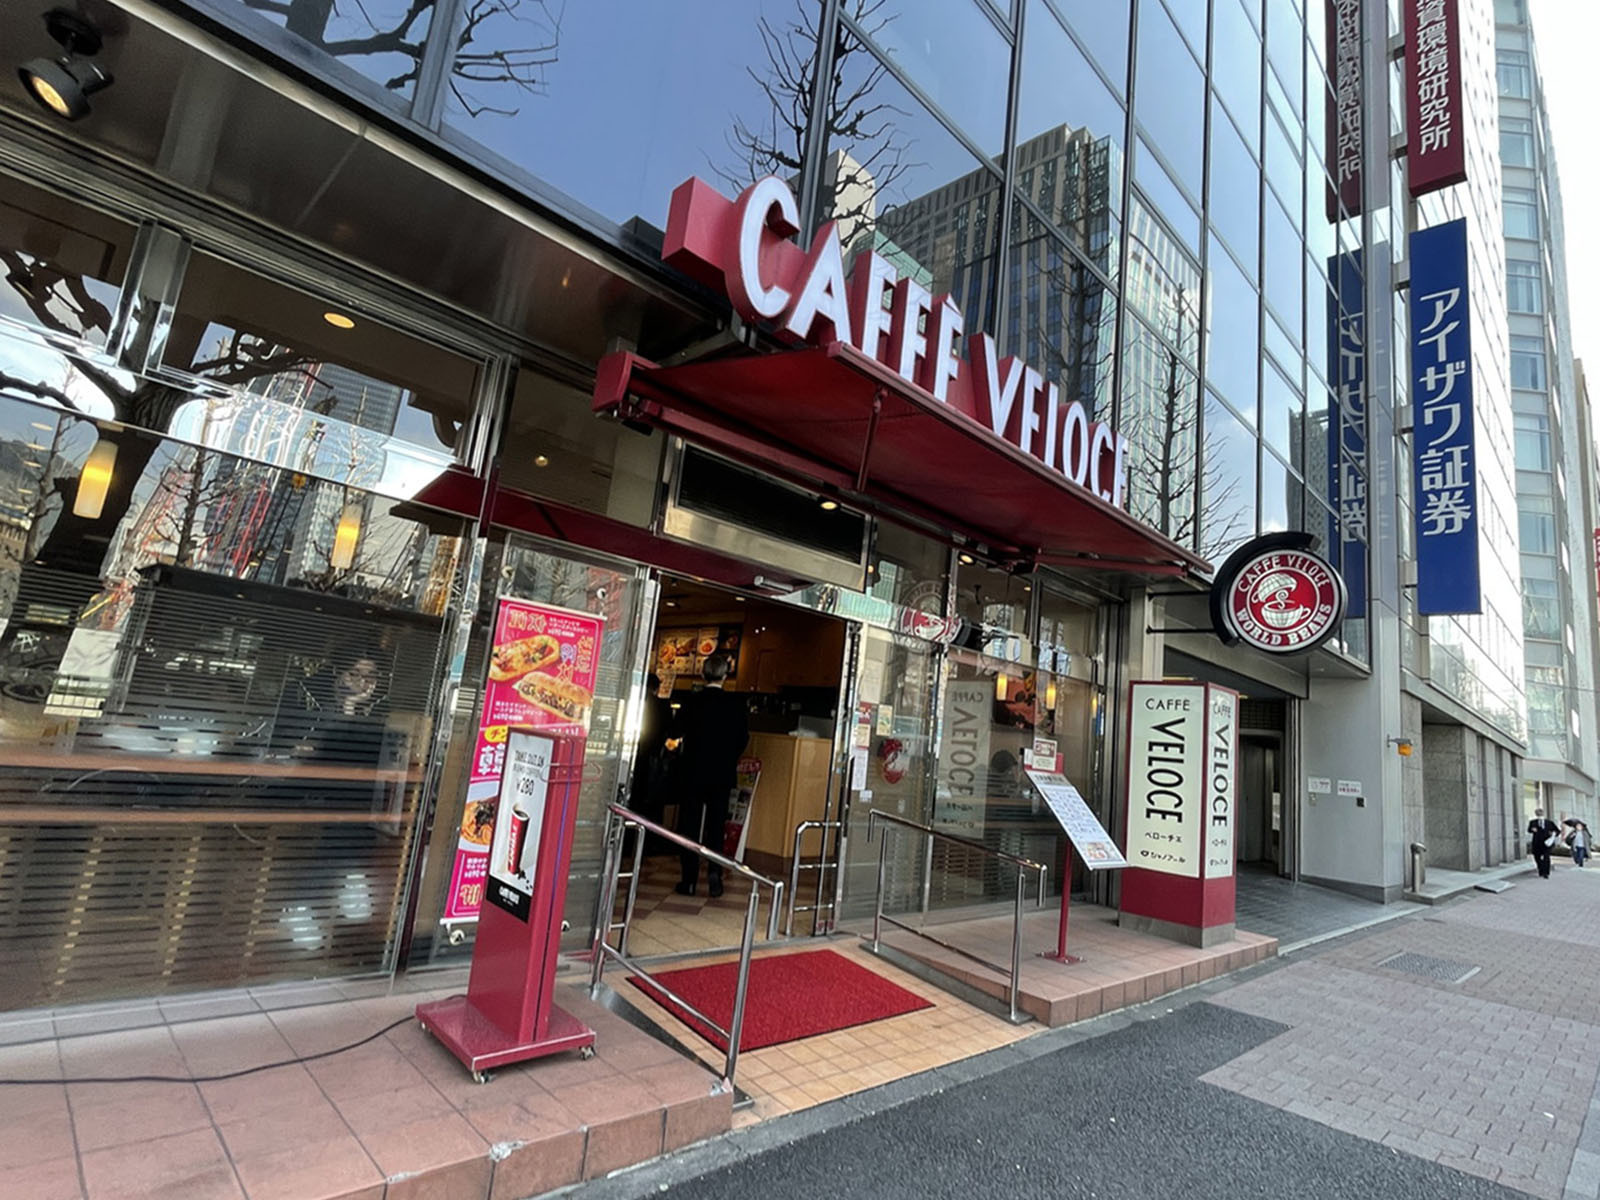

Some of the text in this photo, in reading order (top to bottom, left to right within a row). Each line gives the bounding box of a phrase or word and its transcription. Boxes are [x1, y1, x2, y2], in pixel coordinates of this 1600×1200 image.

[1417, 286, 1472, 537] アイザワ証券
[1287, 555, 1330, 588] VELOCE
[1235, 603, 1332, 646] WORLD BEANS
[1145, 717, 1186, 824] VELOCE
[1212, 724, 1230, 827] VELOCE
